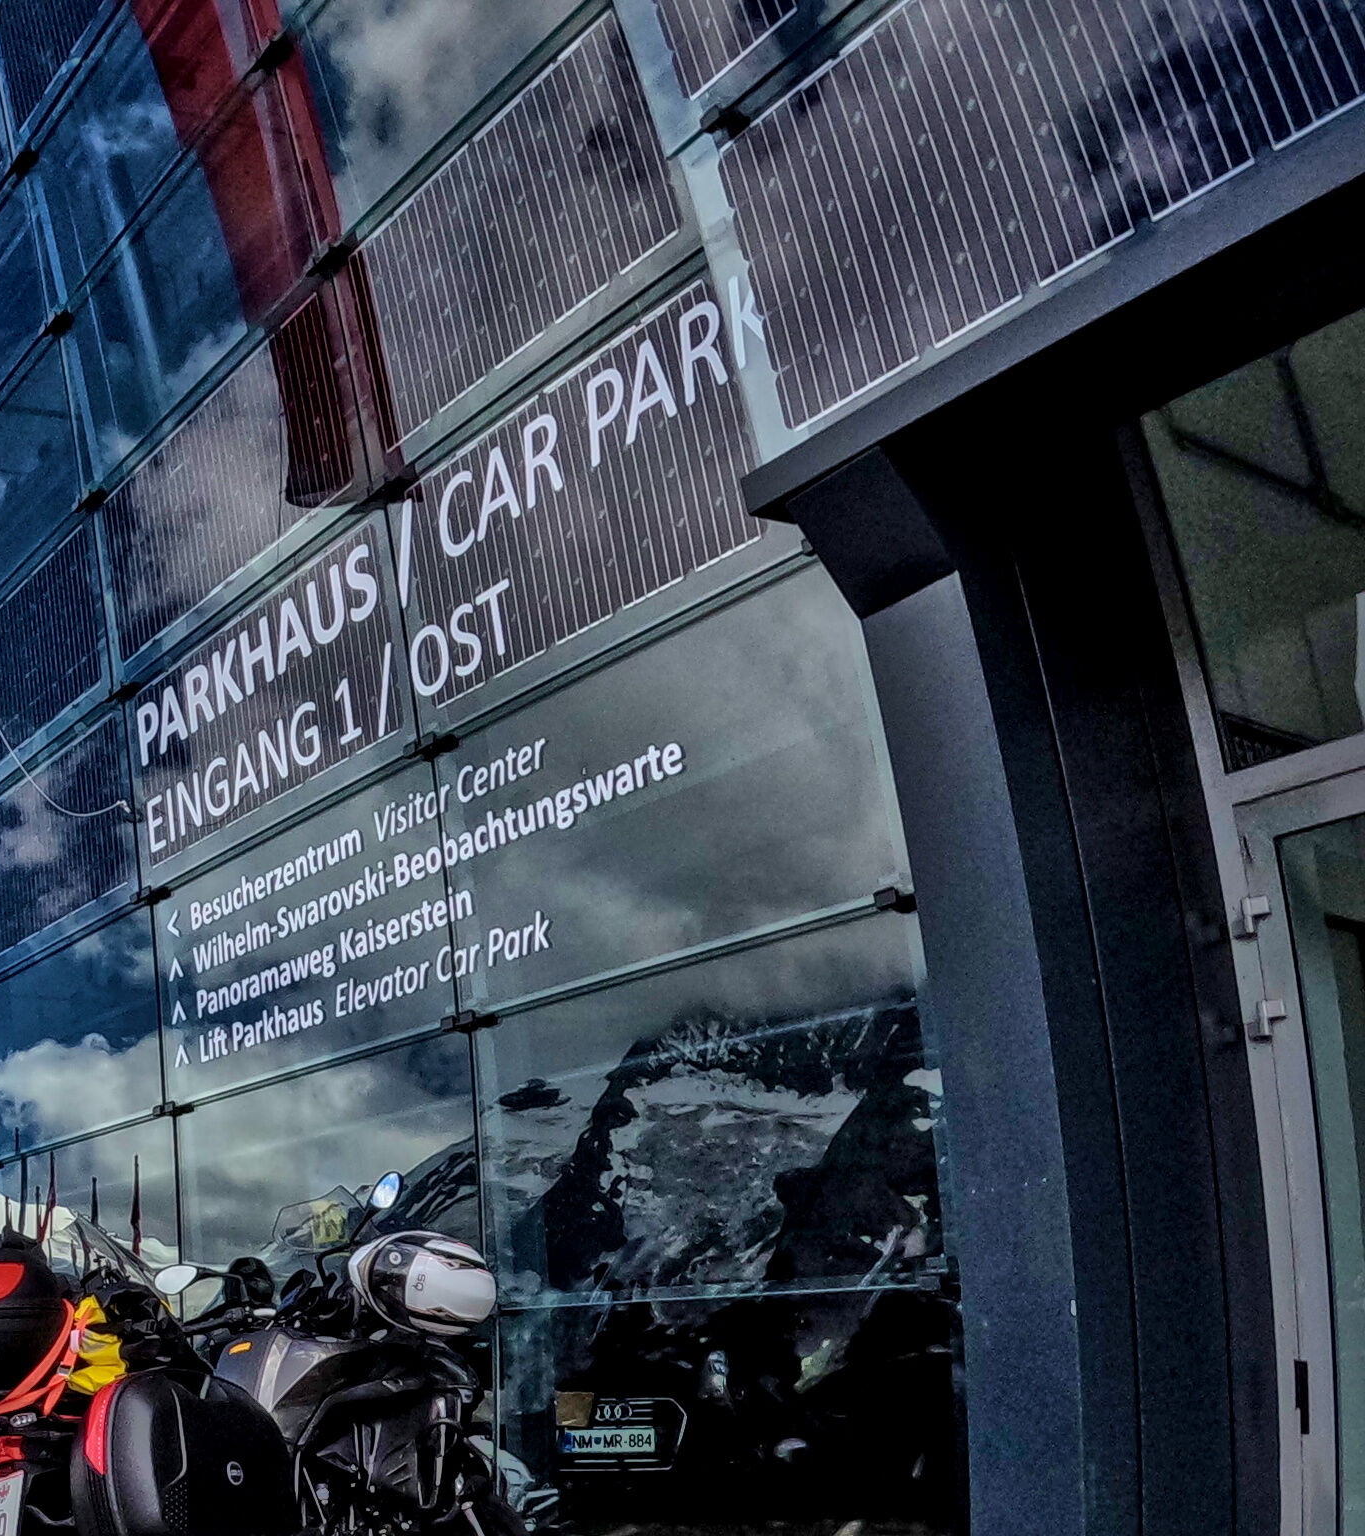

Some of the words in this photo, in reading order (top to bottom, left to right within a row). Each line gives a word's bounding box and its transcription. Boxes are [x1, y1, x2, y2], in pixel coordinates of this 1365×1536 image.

[135, 542, 379, 767] PARKHAUS
[439, 413, 564, 558] CAR
[589, 275, 766, 468] PARK
[145, 701, 322, 855] EINGANG
[334, 678, 363, 747] 1
[410, 579, 512, 697] OST
[189, 828, 363, 932] Besucherzentrum
[373, 782, 450, 844] Visitor
[456, 736, 547, 804] Center
[191, 741, 684, 976] Wilhelm-Swarovski-Beobachtungswarte
[196, 943, 336, 1020] Panoramaweg
[339, 887, 474, 966] Kaiserstein
[198, 1027, 228, 1064] Lift
[232, 999, 324, 1055] Parkhaus
[335, 958, 430, 1018] Elevator
[436, 942, 481, 984] Car
[487, 909, 552, 968] Park
[572, 1434, 593, 1449] NM
[603, 1433, 652, 1449] MR-884
